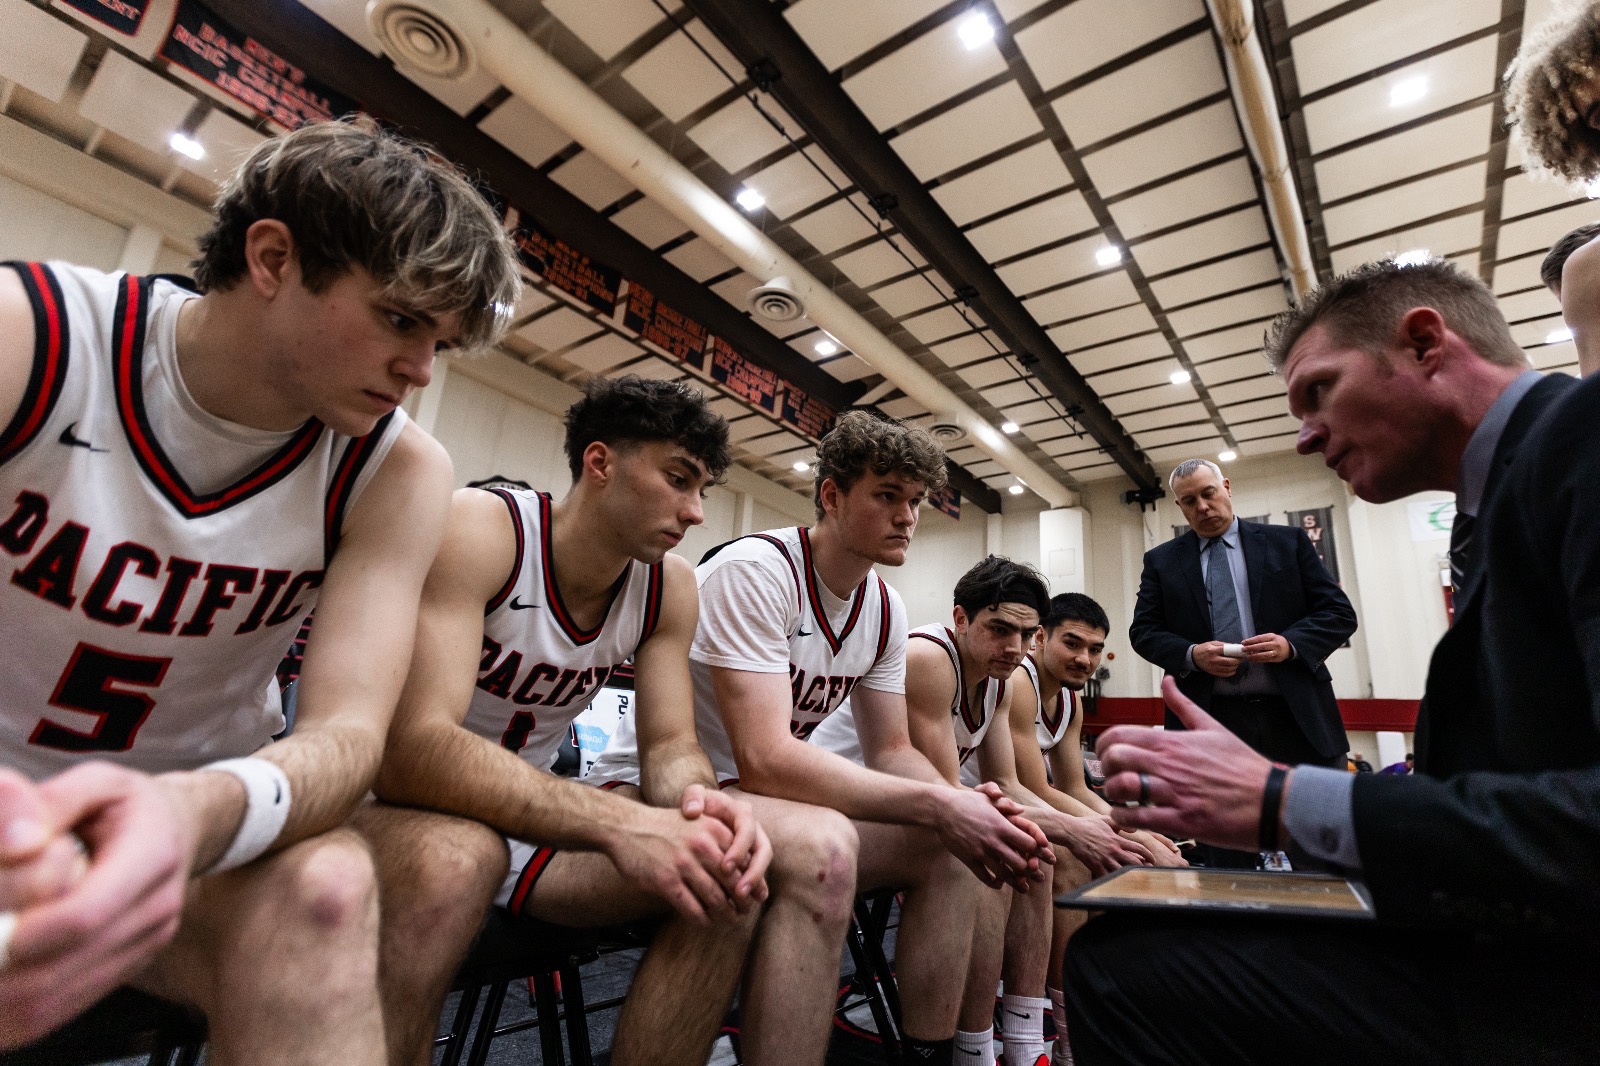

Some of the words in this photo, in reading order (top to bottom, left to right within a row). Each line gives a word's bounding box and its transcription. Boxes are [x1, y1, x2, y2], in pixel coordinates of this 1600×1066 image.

[199, 22, 334, 118] BASKETBALL
[0, 490, 325, 636] PACIFIC
[28, 641, 173, 754] 5
